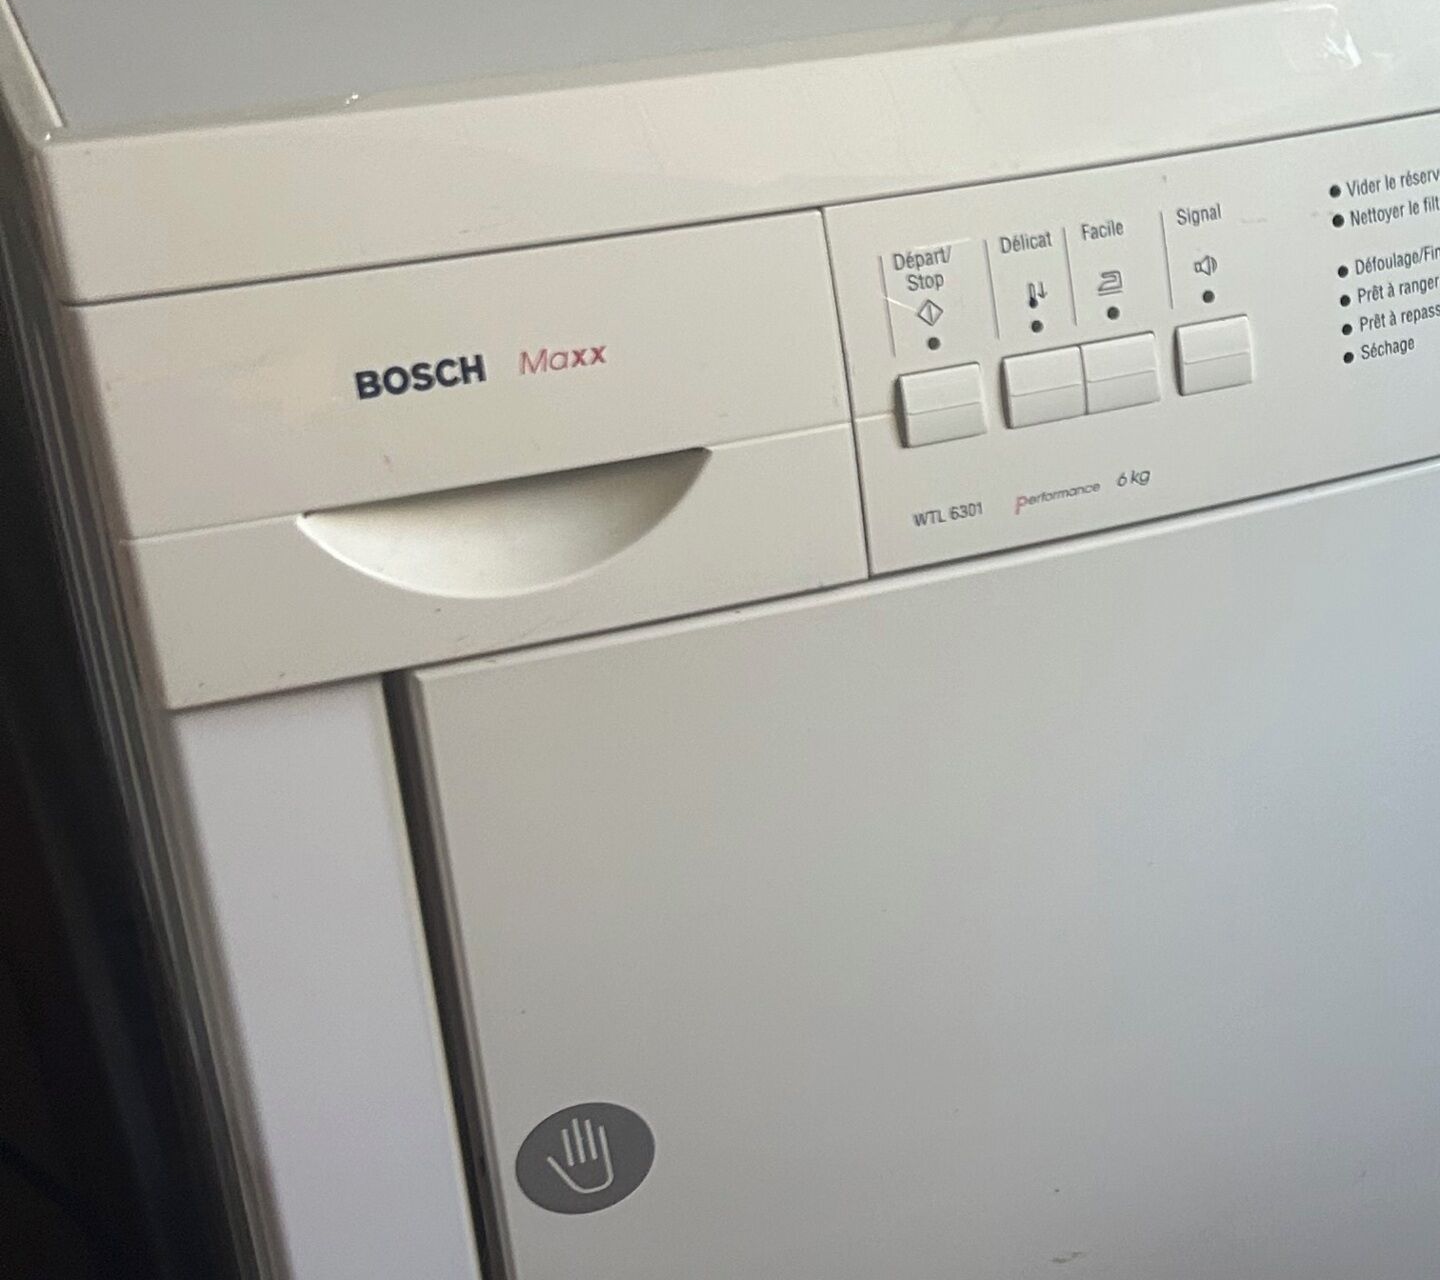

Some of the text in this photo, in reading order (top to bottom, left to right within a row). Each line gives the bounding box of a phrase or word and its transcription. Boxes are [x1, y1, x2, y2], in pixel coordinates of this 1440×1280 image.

[1346, 179, 1381, 197] Vider
[1385, 174, 1396, 191] le
[1176, 203, 1222, 227] Signal
[1350, 204, 1405, 227] Nettoyer
[1408, 200, 1420, 215] le
[1081, 220, 1124, 241] Facile
[1000, 231, 1052, 254] Délicat
[893, 245, 952, 271] Départ/
[907, 273, 944, 291] Stop
[1357, 276, 1439, 304] Prêt à ranger
[1360, 313, 1385, 332] Prêt
[1389, 310, 1397, 326] à
[1360, 338, 1415, 360] Séchage
[355, 344, 607, 400] BOSCH Maxx
[1116, 472, 1127, 487] 6
[1131, 469, 1151, 486] kg
[912, 502, 983, 527] WTL 6301
